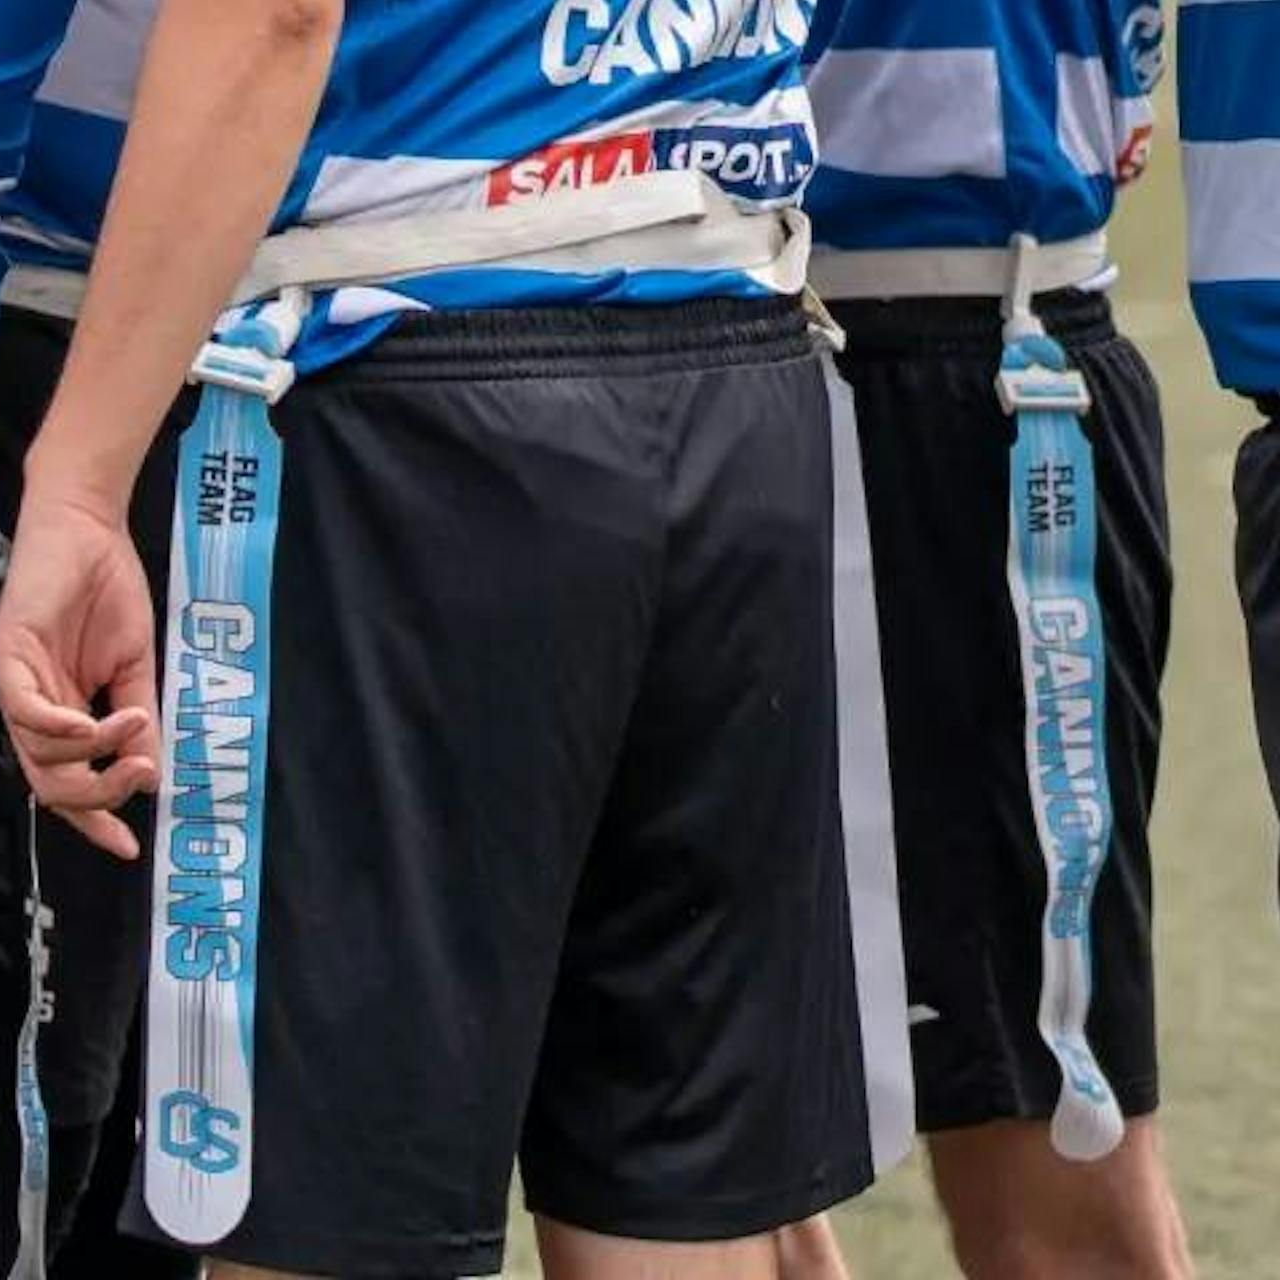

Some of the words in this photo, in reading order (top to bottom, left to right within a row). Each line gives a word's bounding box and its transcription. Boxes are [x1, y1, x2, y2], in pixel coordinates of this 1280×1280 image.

[509, 147, 641, 196] SALA
[197, 450, 226, 527] TEAM
[227, 457, 259, 525] FLAG
[1027, 462, 1049, 532] TEAM
[1053, 465, 1075, 526] FLAG
[164, 598, 257, 986] CANNONS
